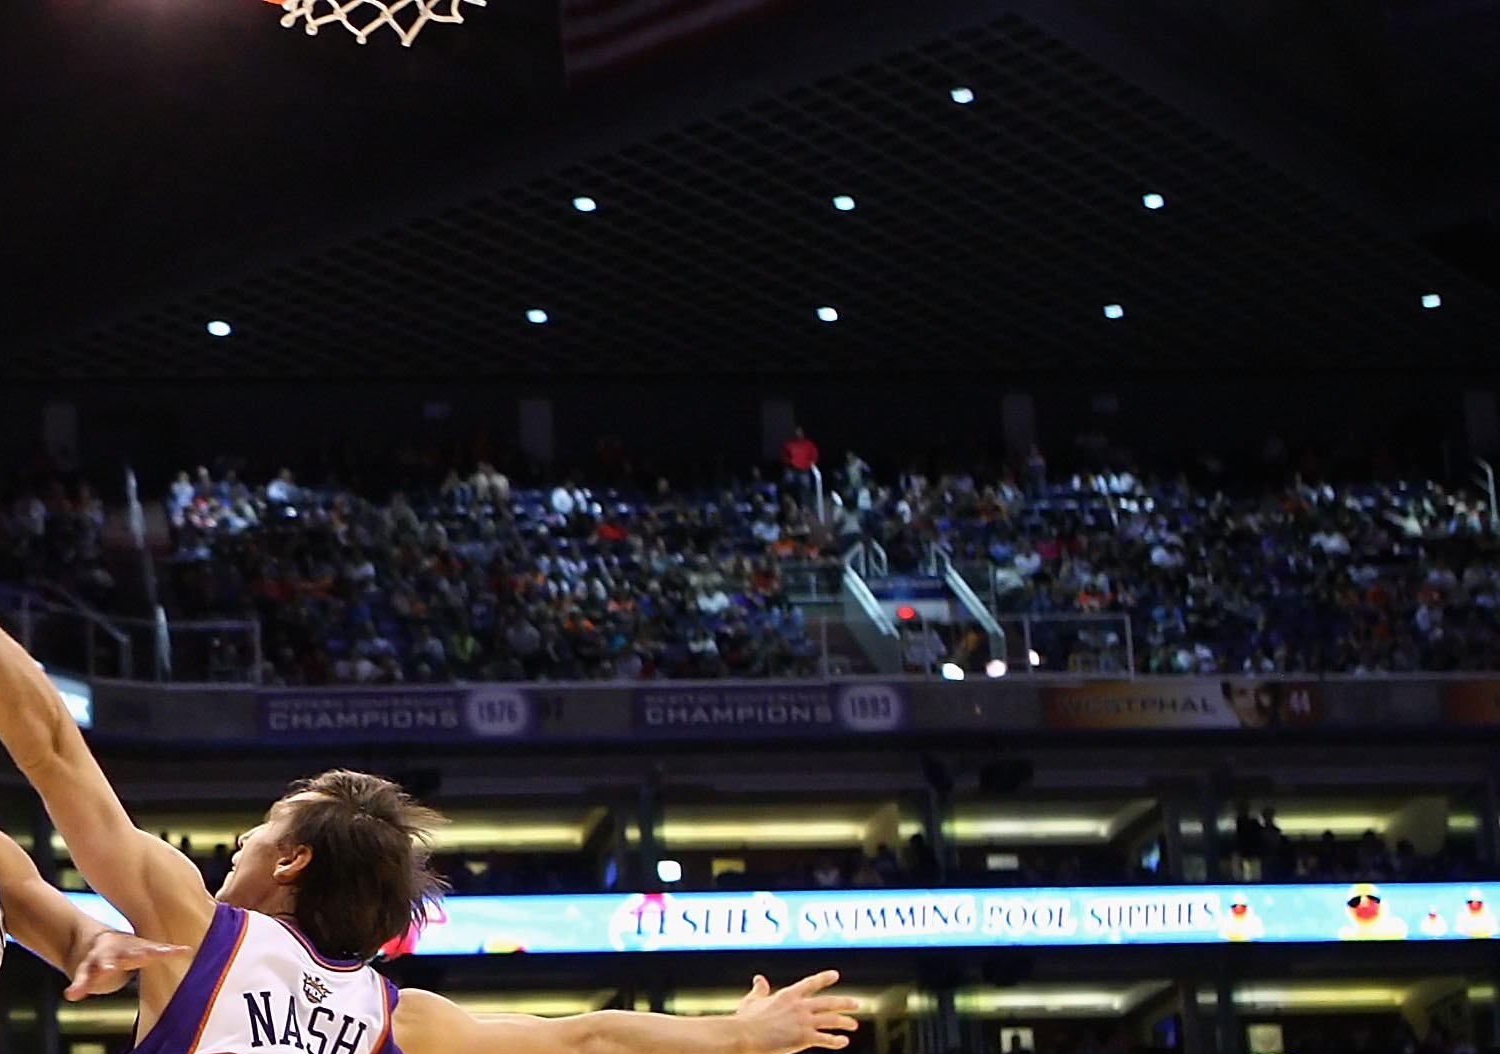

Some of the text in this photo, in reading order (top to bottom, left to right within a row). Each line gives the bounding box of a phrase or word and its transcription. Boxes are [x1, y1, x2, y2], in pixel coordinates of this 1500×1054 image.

[1058, 695, 1217, 713] WESTPHAL
[268, 711, 458, 730] CHAMPIONS
[645, 705, 832, 725] CHAMPIONS
[803, 902, 972, 933] SWIMMING
[988, 904, 1068, 929] POOL
[1090, 900, 1218, 929] SUPPLIES
